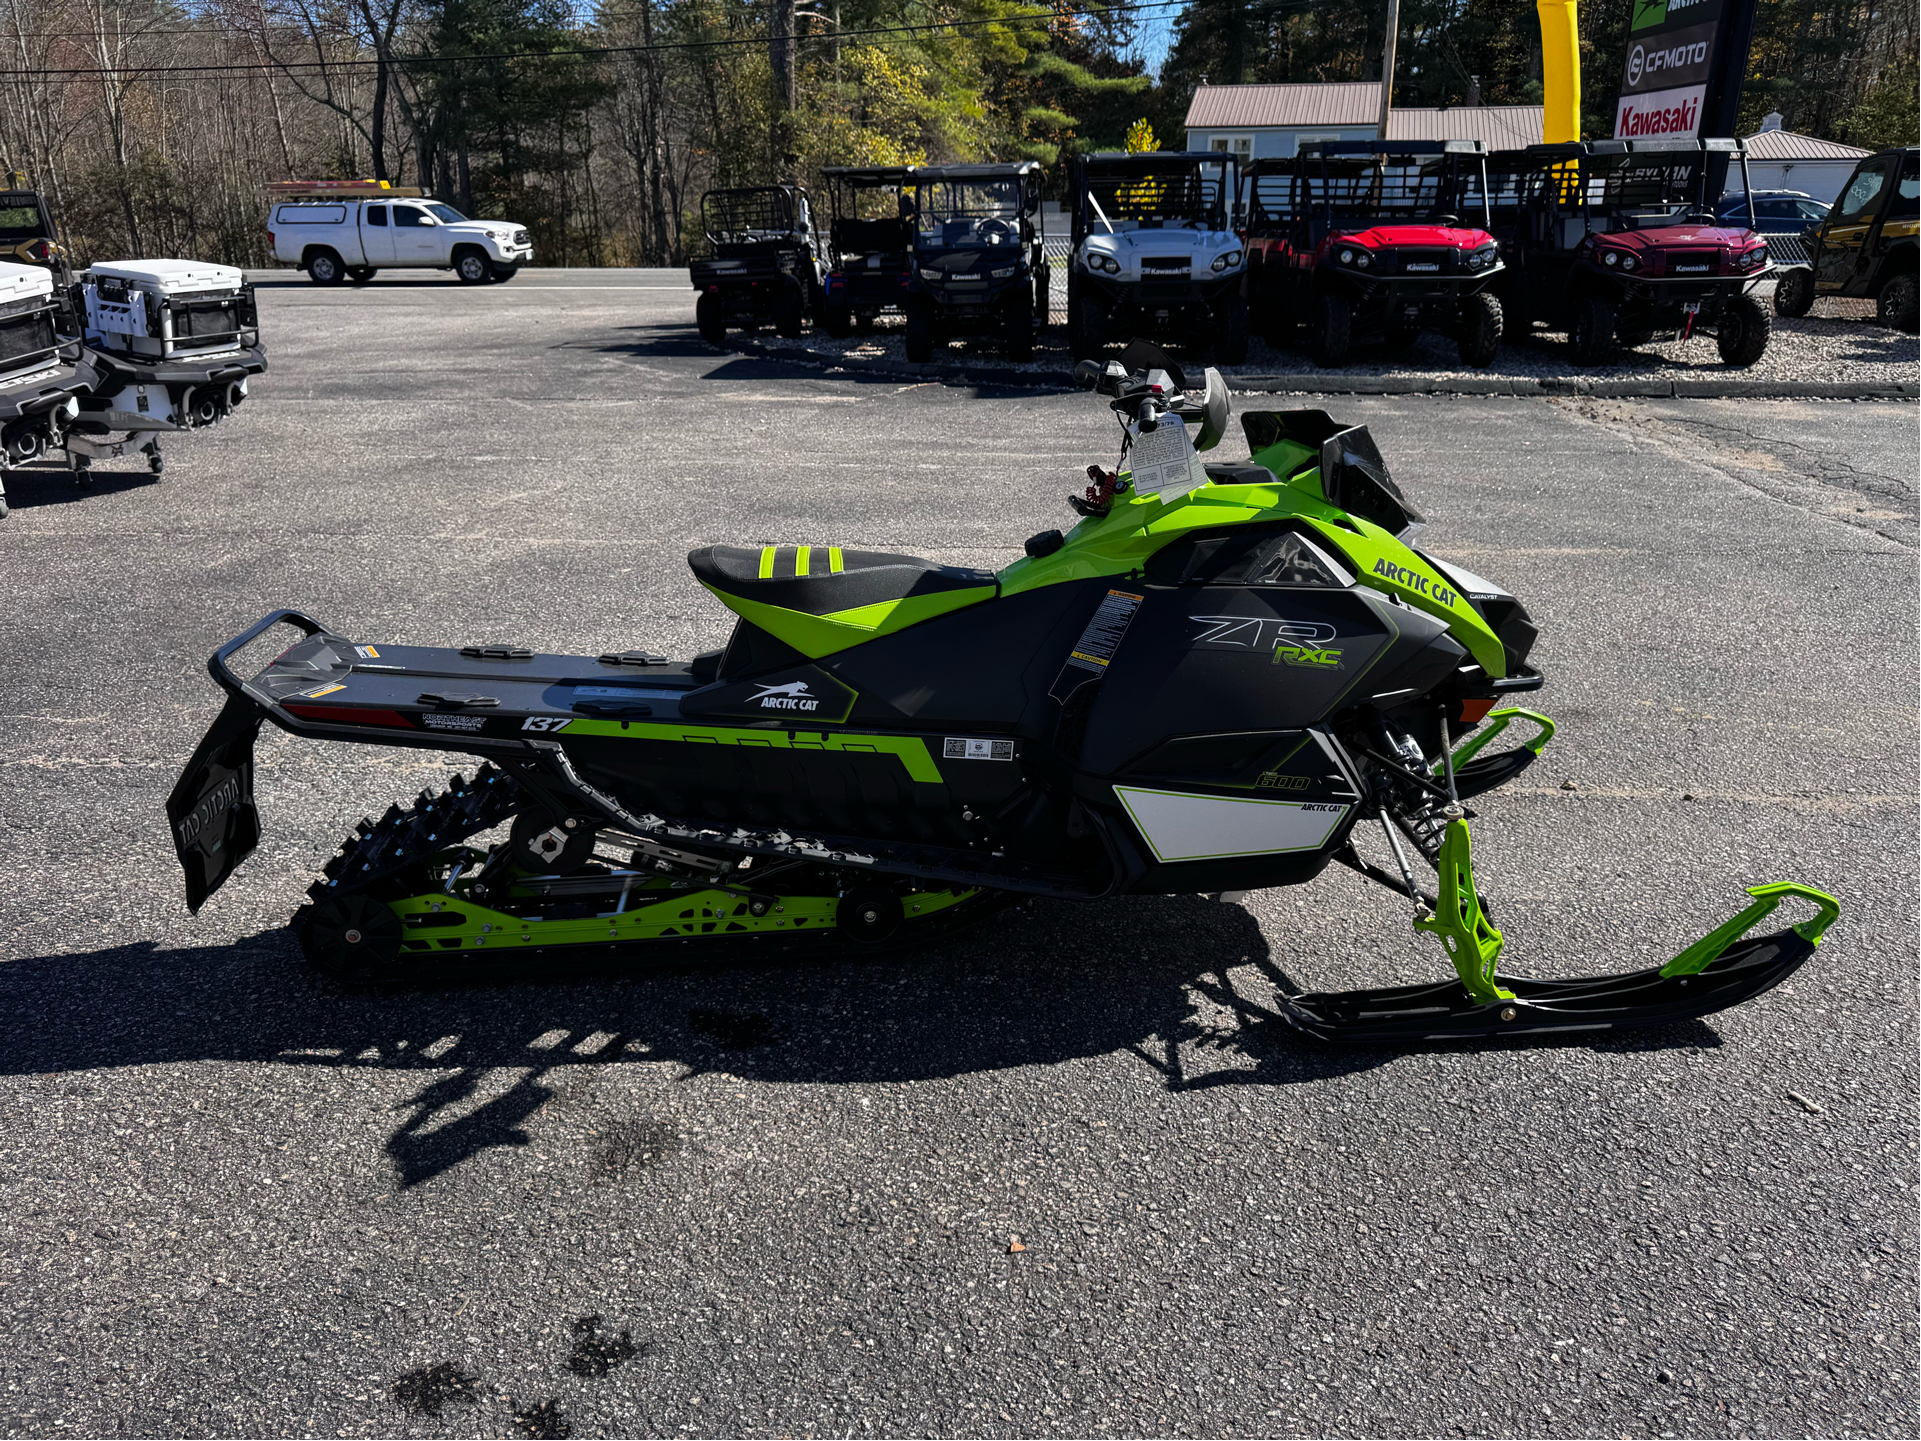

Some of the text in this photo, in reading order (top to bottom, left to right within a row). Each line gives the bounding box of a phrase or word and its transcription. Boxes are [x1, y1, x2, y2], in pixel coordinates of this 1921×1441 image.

[1646, 42, 1706, 72] CFMOTO
[1619, 97, 1698, 137] Kawasaki
[1151, 267, 1182, 275] Kawasaki
[1406, 263, 1440, 272] Kawasaki
[1675, 264, 1710, 272] Kawasaki
[951, 273, 981, 281] Kawasaki
[1373, 557, 1457, 608] ARCTIC CAT
[1188, 615, 1337, 651] ZR
[1081, 654, 1103, 664] CAUTION
[1271, 646, 1342, 668] RXC
[760, 697, 819, 711] ARCTIC CAT
[521, 716, 573, 733] 137
[1255, 774, 1311, 790] 600
[1301, 804, 1342, 813] ARCTIC CAT
